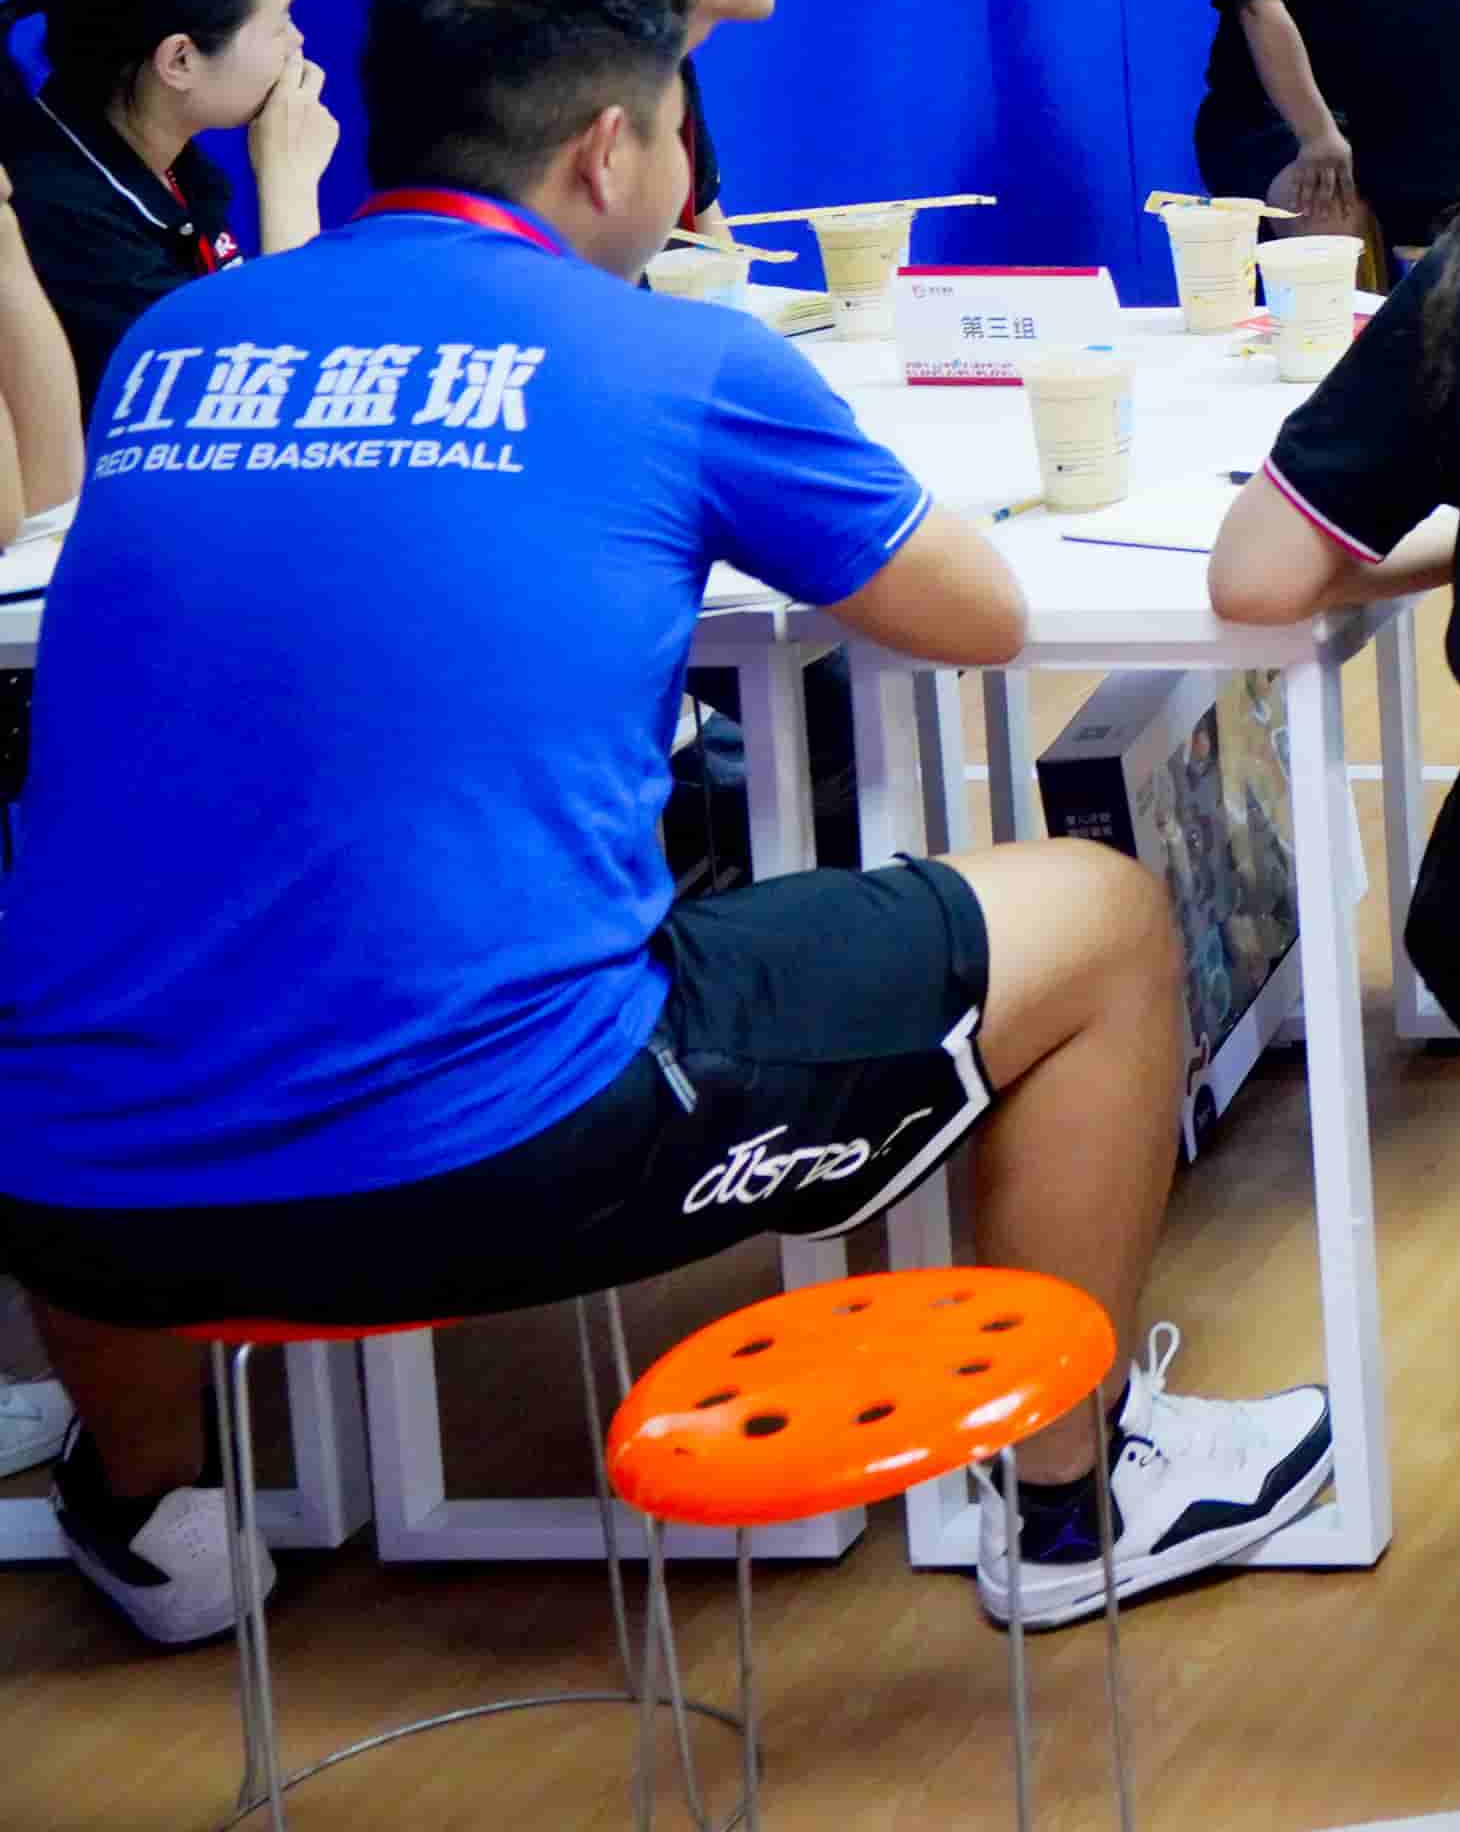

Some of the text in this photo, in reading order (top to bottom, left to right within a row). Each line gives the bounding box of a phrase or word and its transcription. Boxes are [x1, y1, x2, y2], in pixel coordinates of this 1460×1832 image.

[961, 315, 1037, 339] 第三组
[106, 342, 546, 439] 红蓝篮球
[95, 439, 524, 480] RED BLUE BASKETBALL
